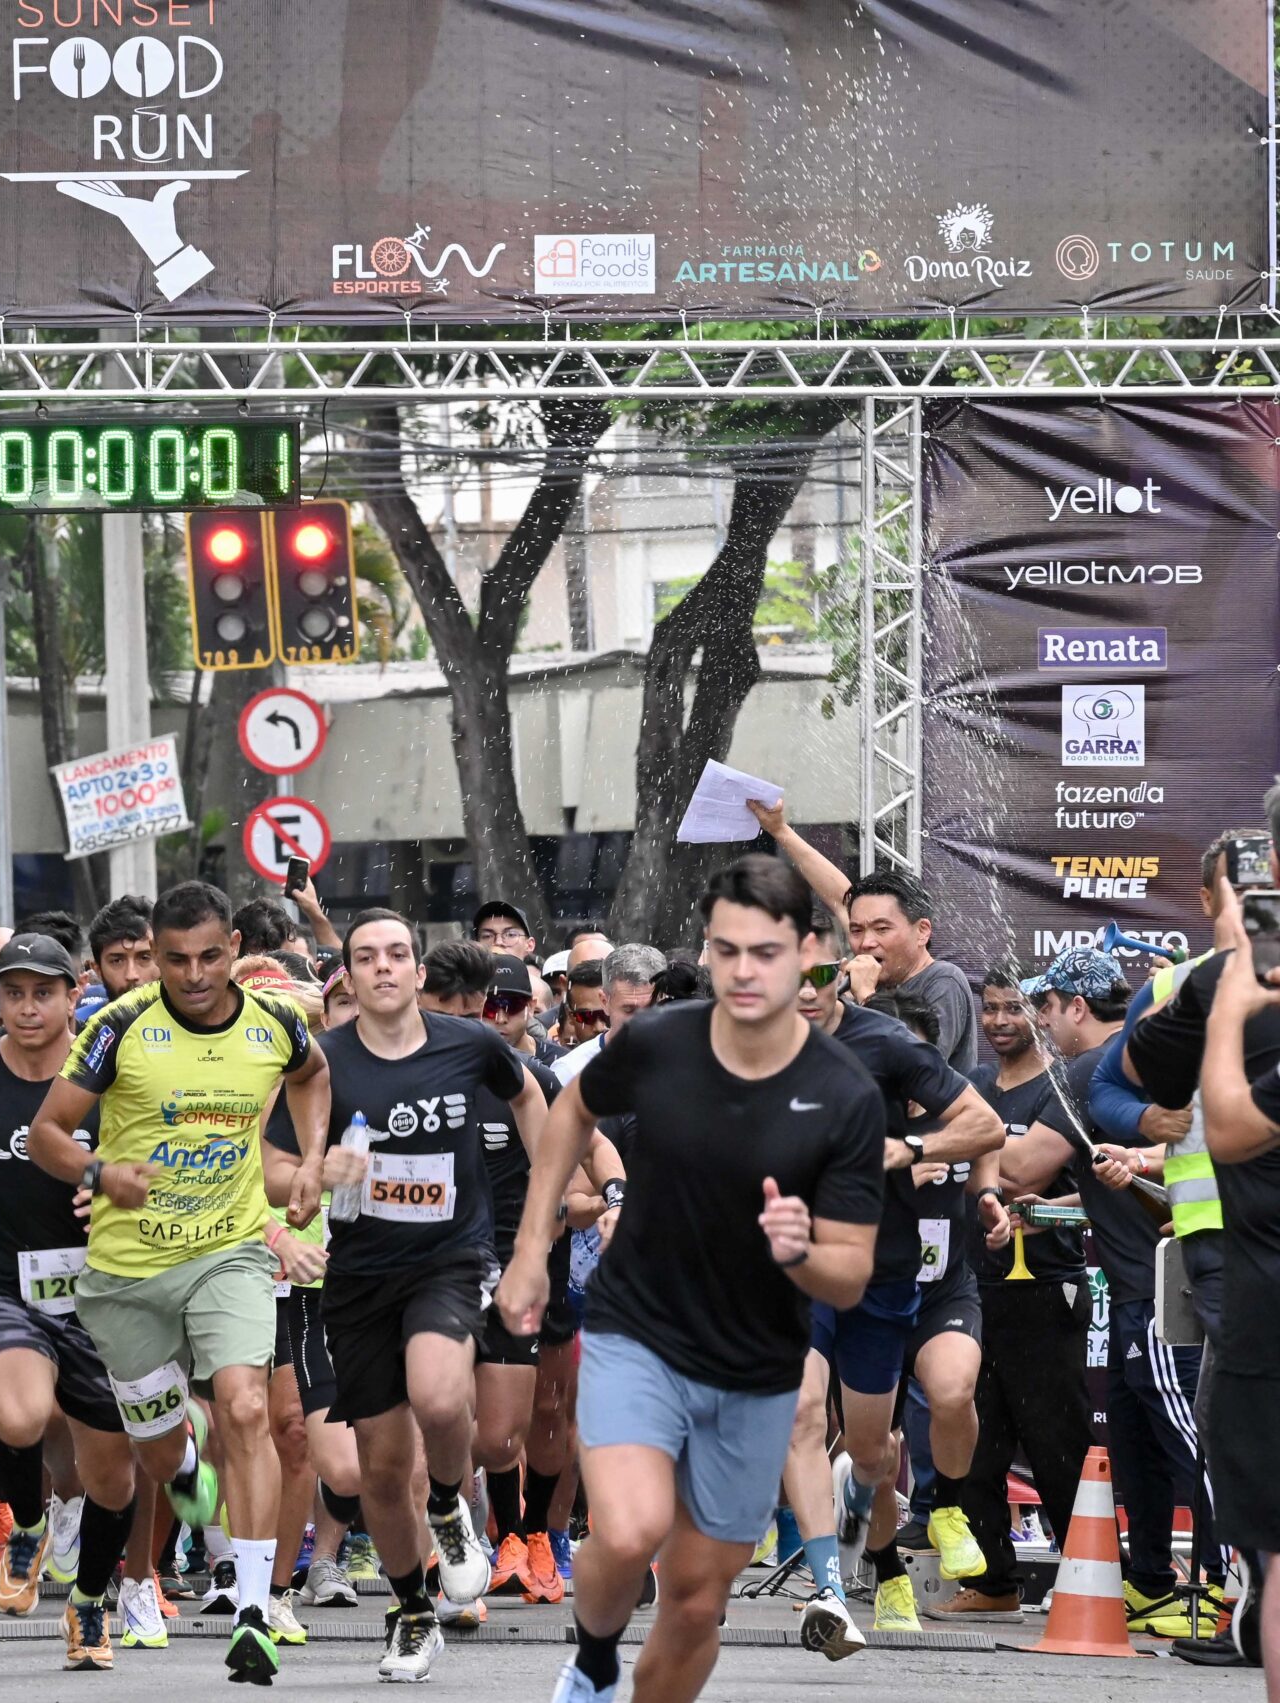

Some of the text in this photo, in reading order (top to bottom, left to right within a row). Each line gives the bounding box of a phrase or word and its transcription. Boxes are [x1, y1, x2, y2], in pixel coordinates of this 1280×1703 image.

[16, 0, 221, 27] SUNSET
[13, 35, 224, 101] FOOD
[92, 112, 214, 162] RUN
[581, 238, 652, 262] family
[1107, 241, 1236, 263] TOTUM
[581, 259, 649, 277] foods
[673, 261, 860, 283] ARTESANAL
[903, 254, 1033, 288] Dona Raiz
[1185, 268, 1234, 281] SAÚDE
[332, 281, 422, 295] ESPORTES
[1044, 477, 1162, 522] yellot
[1043, 634, 1161, 662] Renata
[1055, 781, 1164, 803] fazenda
[1051, 856, 1160, 878] TENNIS
[1063, 877, 1148, 899] PLACE
[184, 1101, 260, 1114] APARECIDA
[373, 1181, 443, 1206] 5409
[194, 1215, 236, 1241] LIFE
